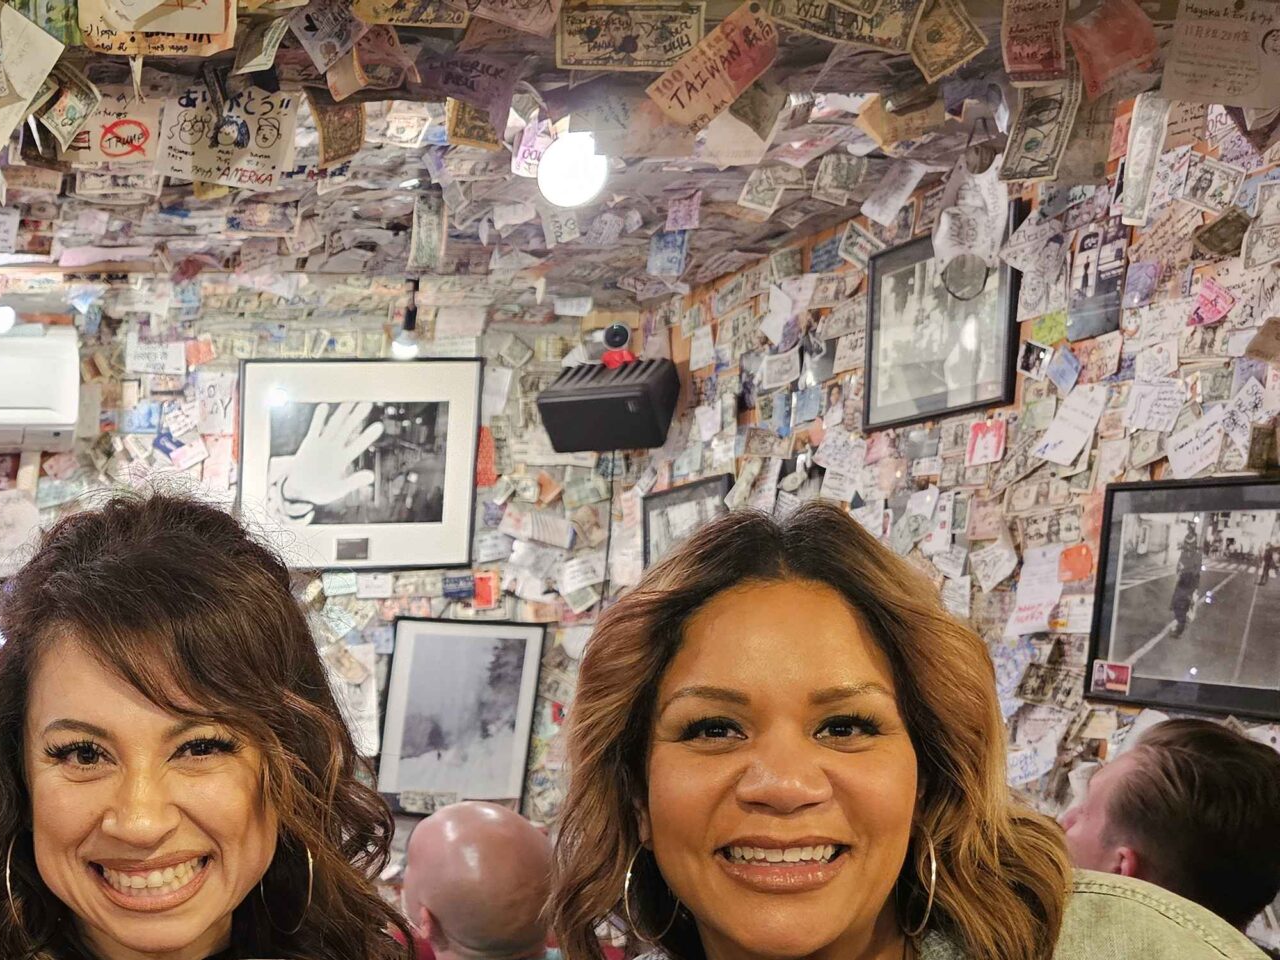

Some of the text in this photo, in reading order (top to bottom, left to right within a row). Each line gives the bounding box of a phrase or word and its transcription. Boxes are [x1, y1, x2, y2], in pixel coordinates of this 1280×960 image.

[428, 57, 506, 79] LIMERICK
[668, 41, 745, 110] TAIWAN
[104, 132, 145, 150] TRUMP
